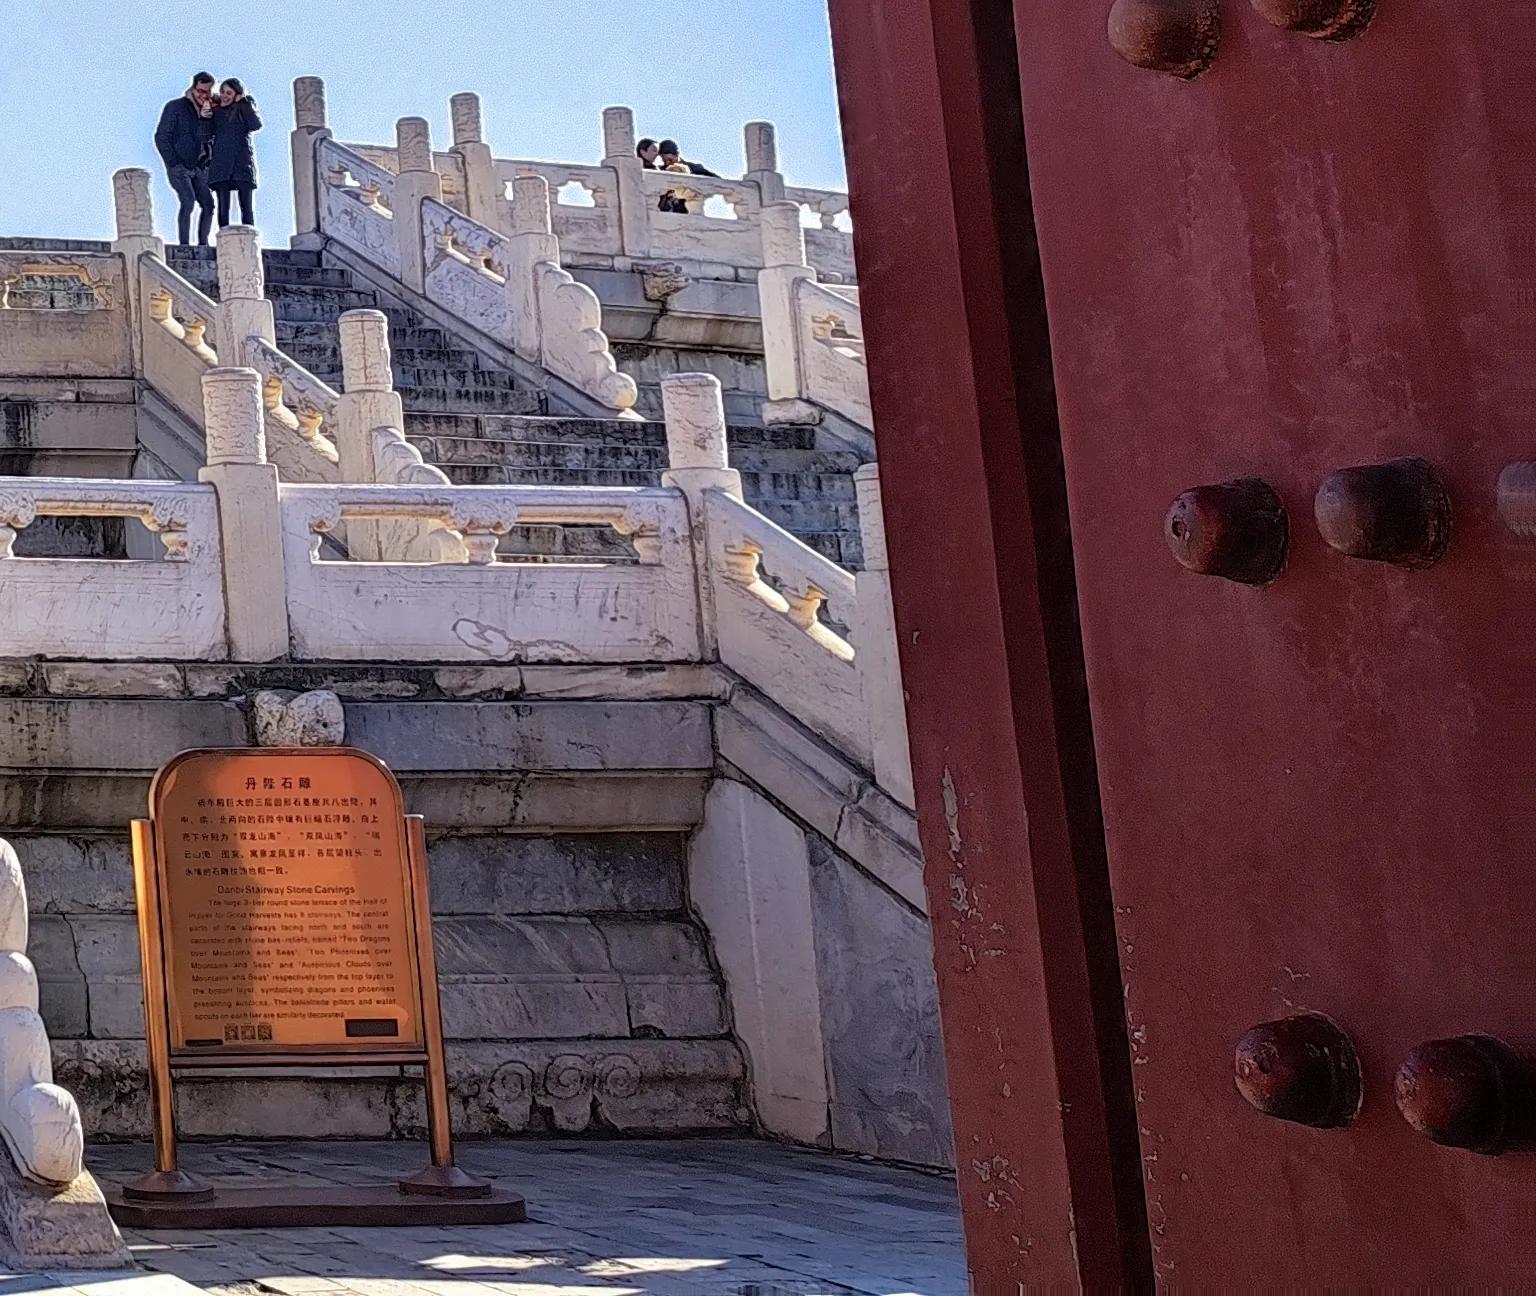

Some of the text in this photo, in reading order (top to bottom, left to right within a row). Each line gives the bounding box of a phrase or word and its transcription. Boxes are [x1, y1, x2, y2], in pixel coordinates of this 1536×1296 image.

[245, 777, 312, 790] 丹陛石雕
[245, 886, 284, 895] Stairway
[287, 886, 312, 894] Stone
[314, 885, 355, 895] Carvings
[360, 935, 390, 943] Dragons
